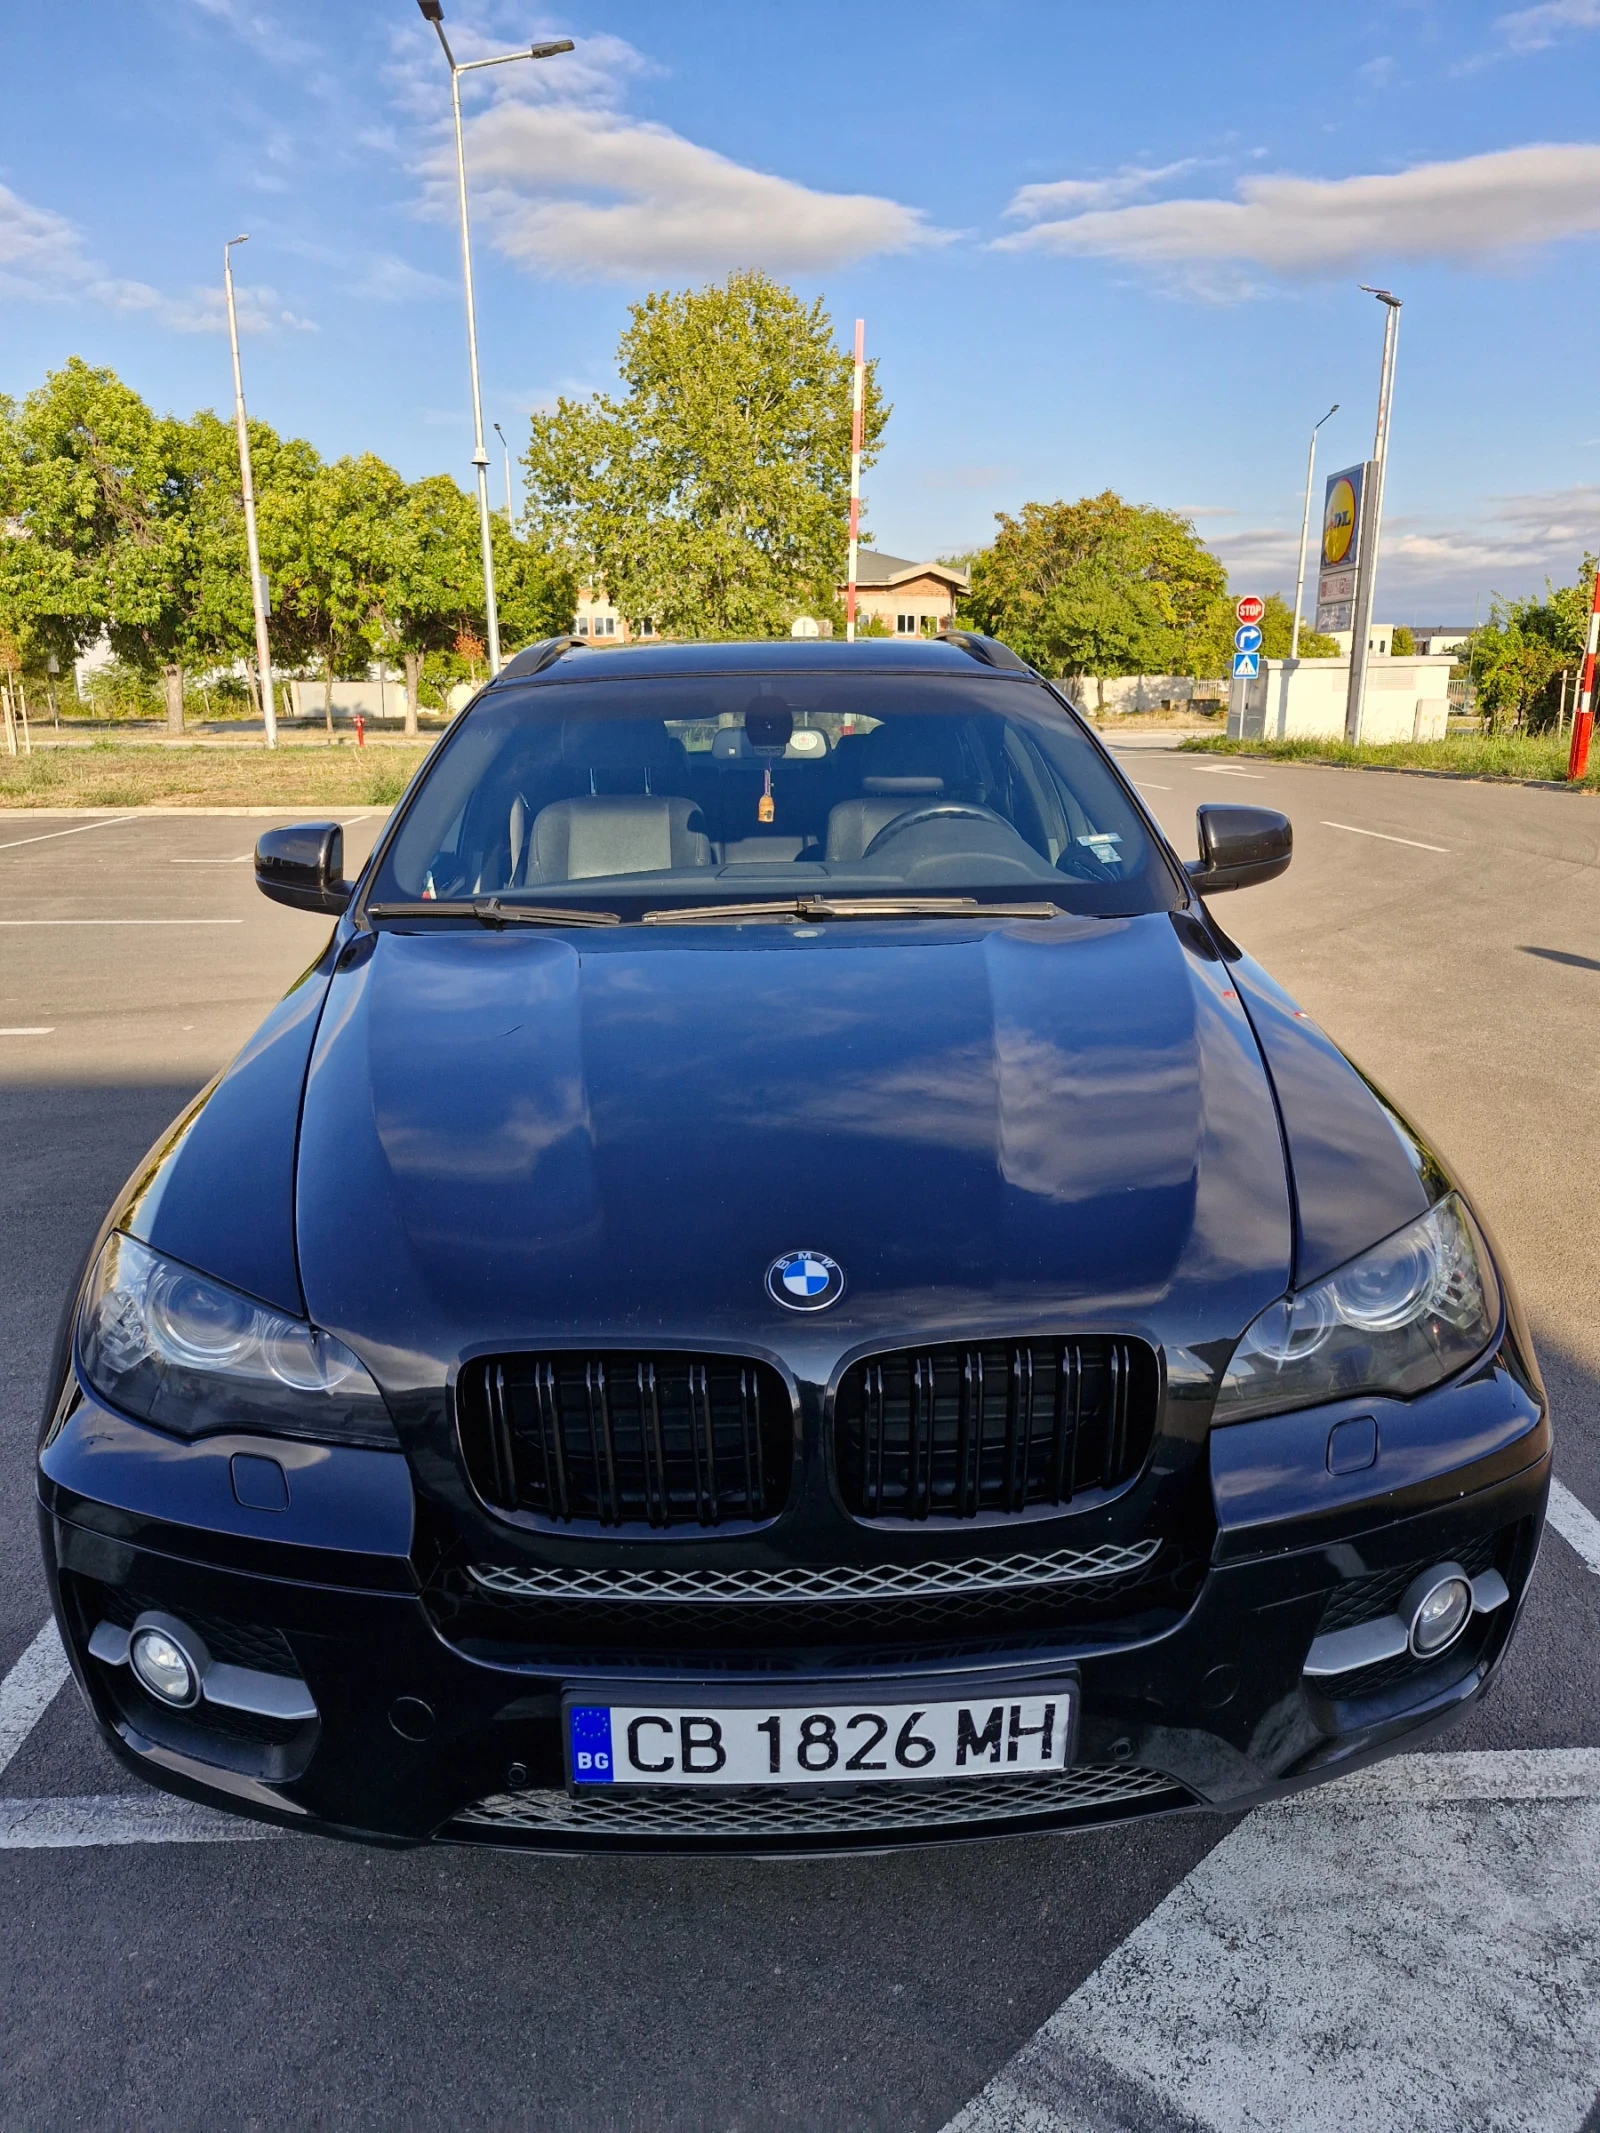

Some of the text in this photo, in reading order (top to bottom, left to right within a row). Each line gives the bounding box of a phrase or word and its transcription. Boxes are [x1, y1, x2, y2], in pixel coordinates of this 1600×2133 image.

[1326, 507, 1351, 531] IDL
[1239, 604, 1262, 616] STOP
[776, 1252, 836, 1270] BMW
[627, 1703, 1056, 1774] CB 1826 MH
[577, 1752, 609, 1769] BG
